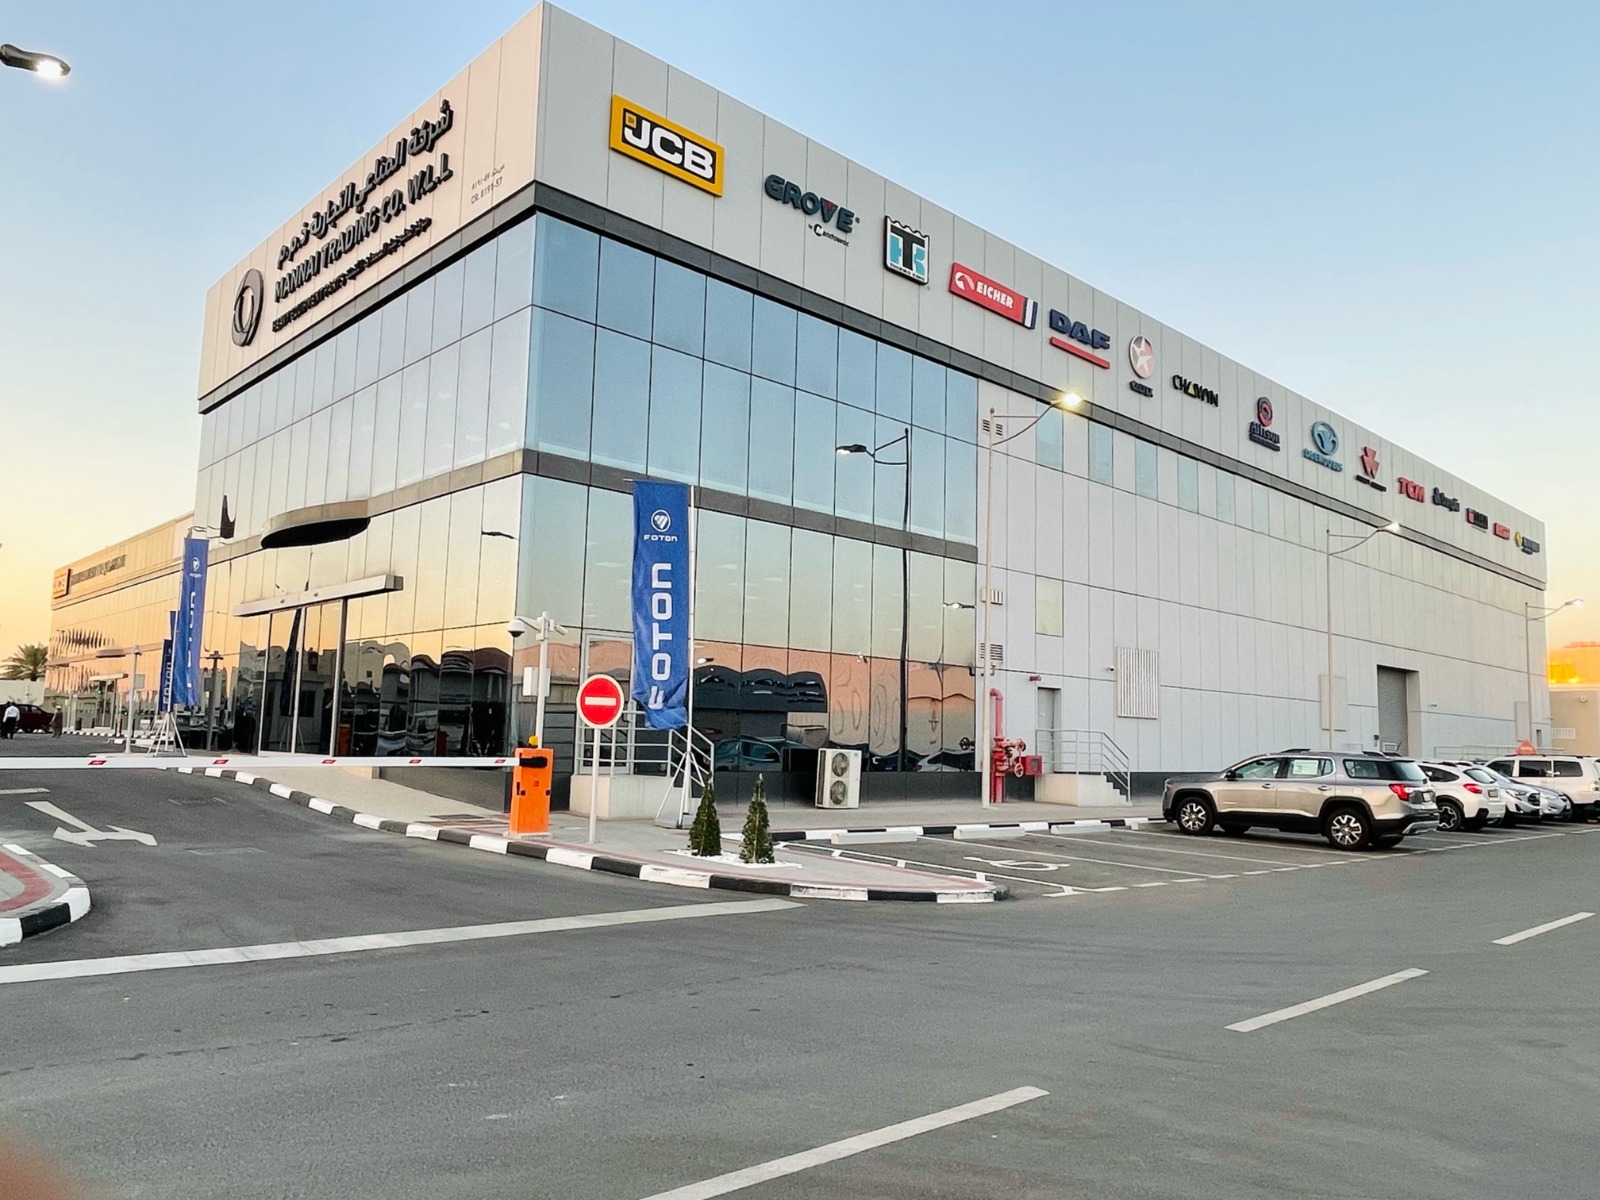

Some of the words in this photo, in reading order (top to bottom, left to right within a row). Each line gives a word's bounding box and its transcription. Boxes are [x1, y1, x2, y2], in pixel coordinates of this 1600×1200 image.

[407, 99, 453, 155] شركة
[624, 119, 713, 178] JCB
[353, 138, 407, 213] المناعي
[765, 174, 854, 233] GROVE
[310, 182, 356, 241] التجارية
[274, 248, 322, 303] MANNAI
[320, 206, 380, 270] TRADING
[380, 189, 406, 222] CO.
[976, 281, 1014, 309] EICHER
[1050, 309, 1110, 349] DAF
[1399, 477, 1425, 503] TCM
[643, 534, 678, 542] FOTON
[648, 562, 672, 710] FOTON
